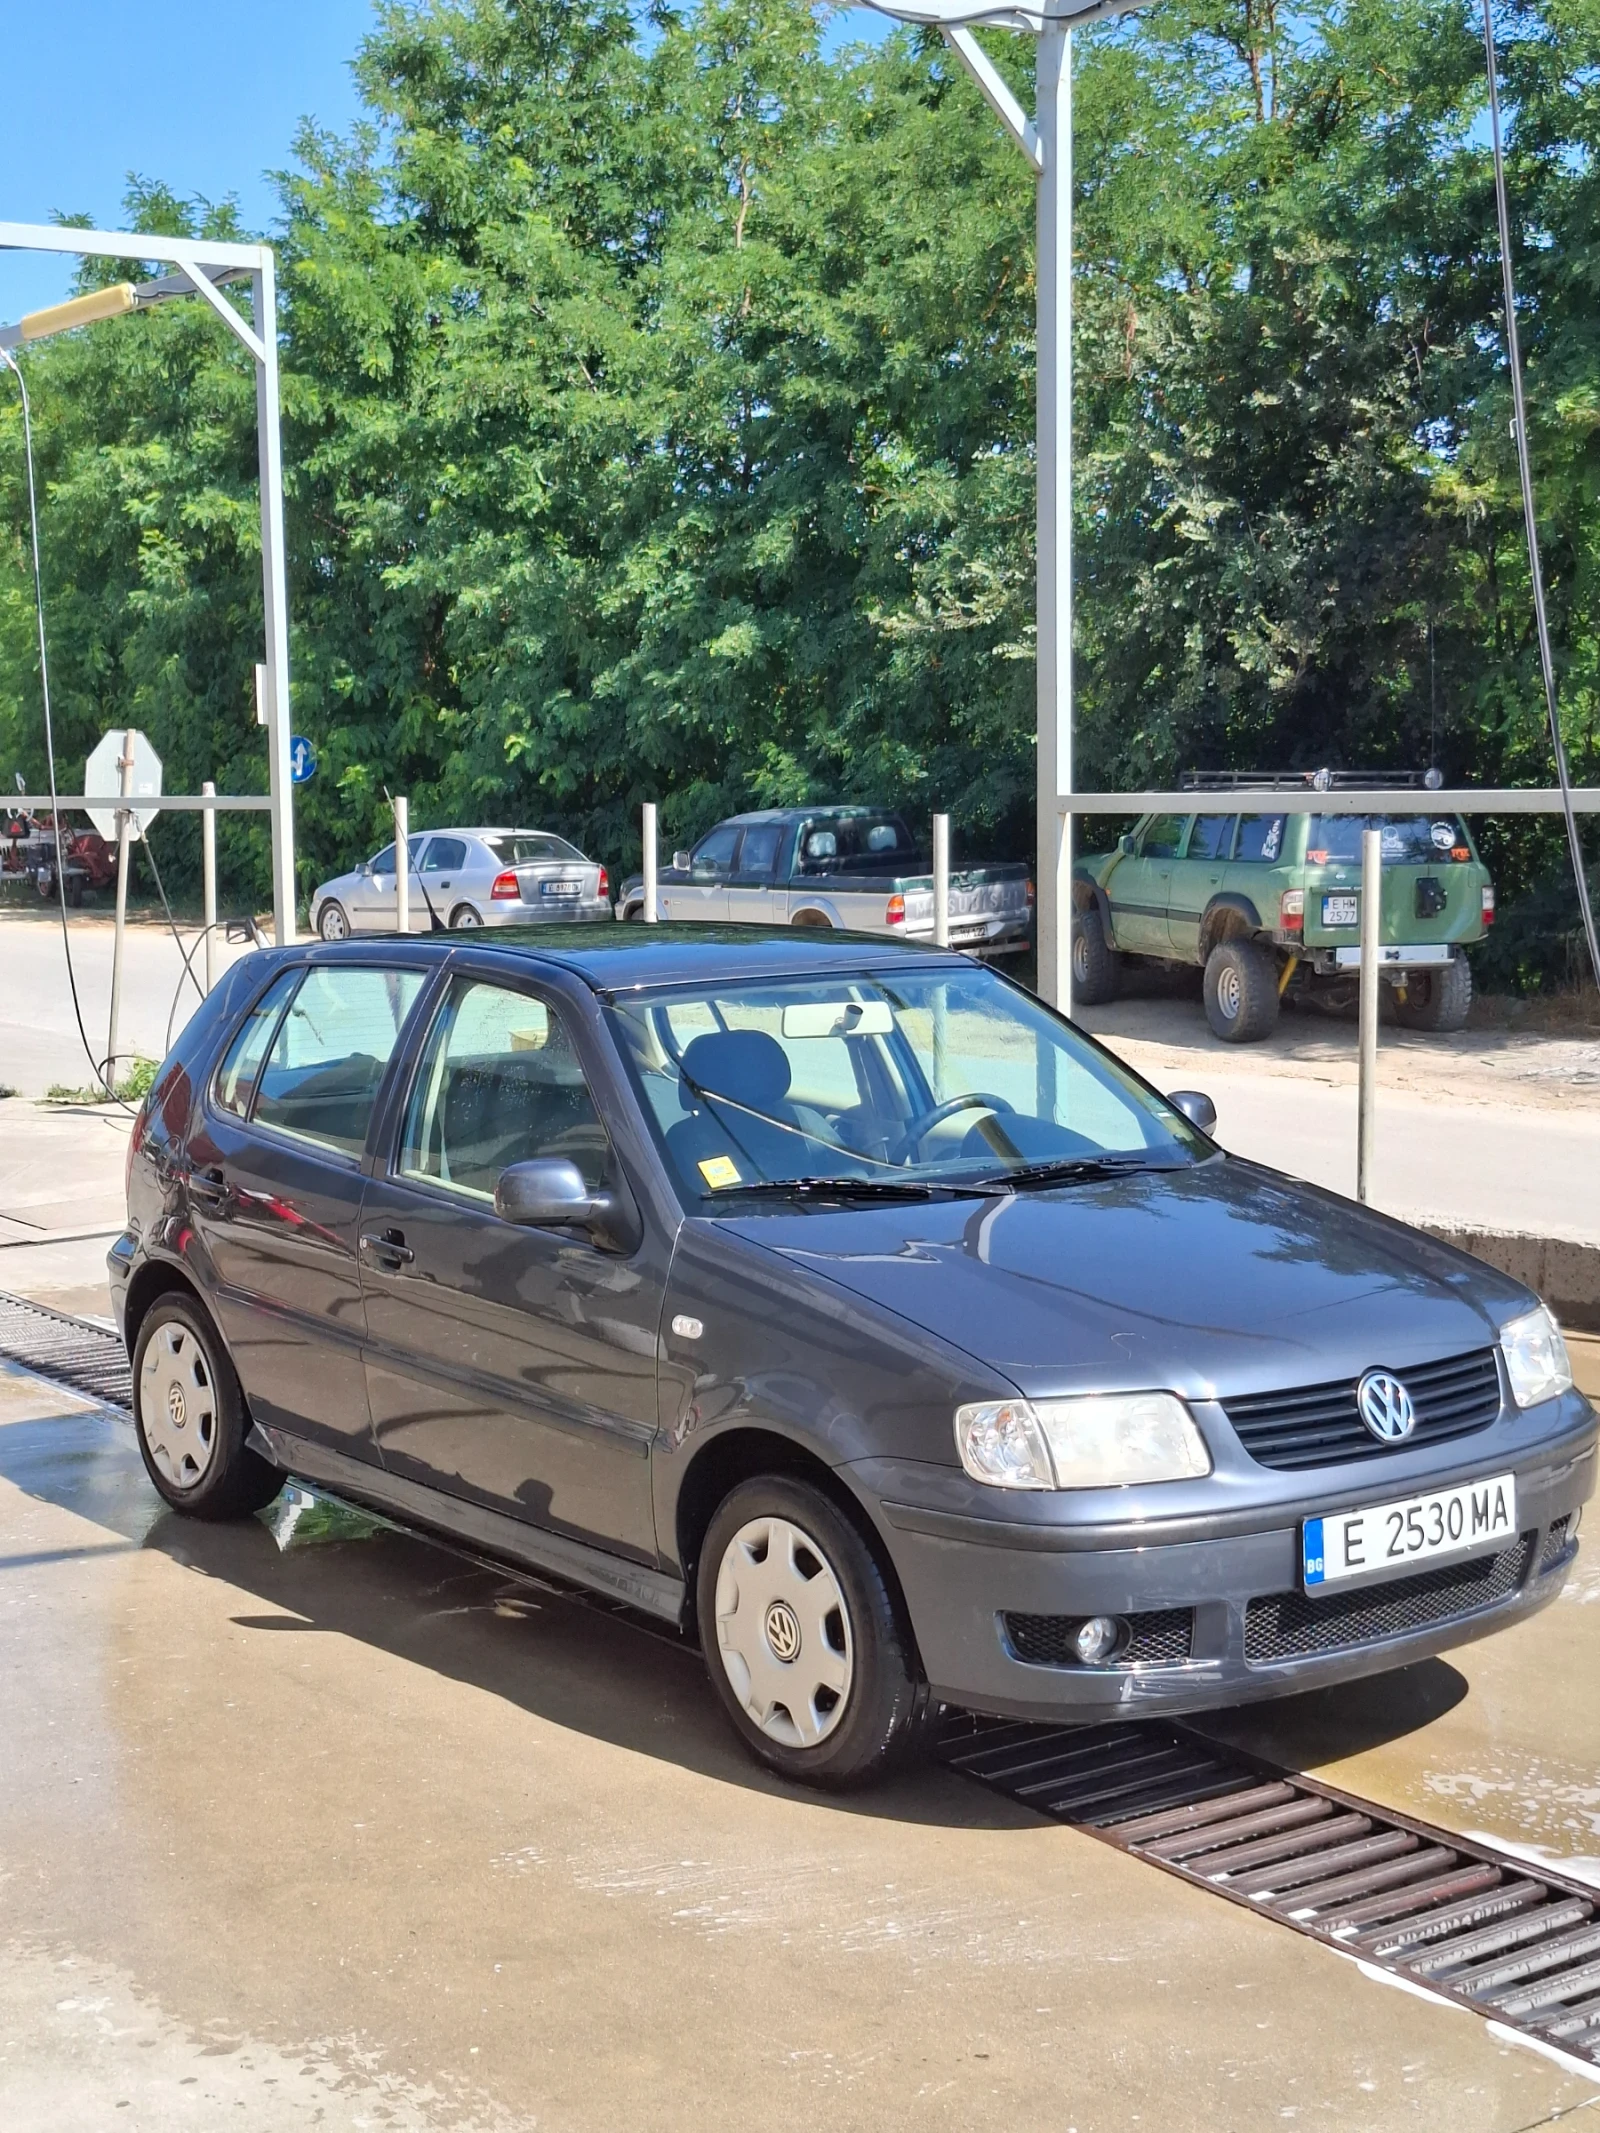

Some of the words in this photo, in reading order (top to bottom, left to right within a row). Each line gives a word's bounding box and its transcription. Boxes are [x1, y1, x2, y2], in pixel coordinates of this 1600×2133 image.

[1332, 899, 1339, 909] E
[1329, 910, 1356, 922] 2577
[1359, 1371, 1414, 1443] VW
[1343, 1518, 1365, 1567] E
[1386, 1497, 1464, 1558] 2530
[1471, 1485, 1508, 1536] MA
[1306, 1557, 1323, 1574] BG
